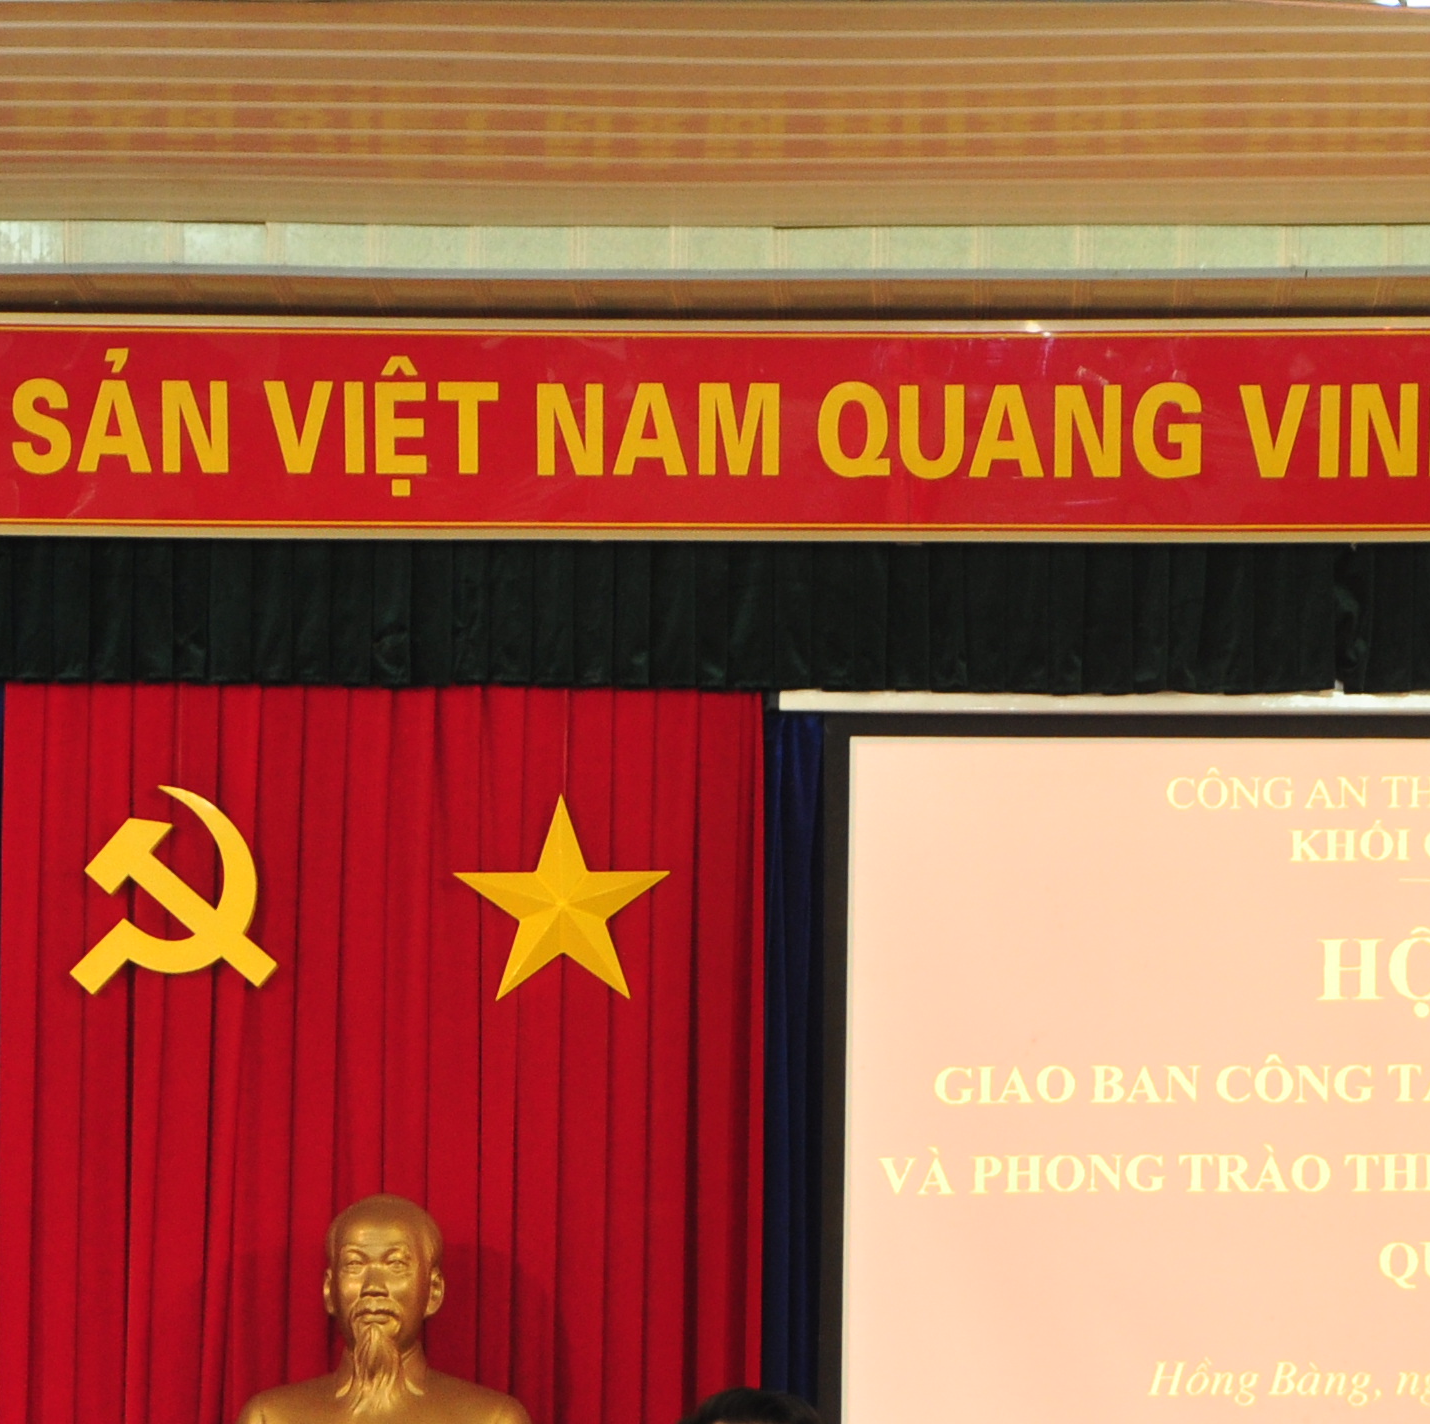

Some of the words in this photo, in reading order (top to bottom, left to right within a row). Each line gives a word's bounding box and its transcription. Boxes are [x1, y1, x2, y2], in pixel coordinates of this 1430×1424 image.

[13, 349, 228, 474] SẢN
[264, 356, 498, 496] VIỆT
[537, 383, 779, 475] NAM
[818, 382, 1201, 479] QUANG
[1166, 766, 1294, 809] CÔNG
[1305, 775, 1368, 809] AN
[1290, 819, 1410, 862] KHỐI
[934, 1065, 1076, 1105] GIAO
[1091, 1065, 1200, 1104] BAN
[1216, 1054, 1374, 1103] CÔNG
[879, 1147, 955, 1195] VÀ
[971, 1153, 1165, 1194] PHONG
[1179, 1144, 1331, 1192] TRÀO
[1148, 1357, 1259, 1405] Hồng
[1269, 1360, 1382, 1406] Bàng,
